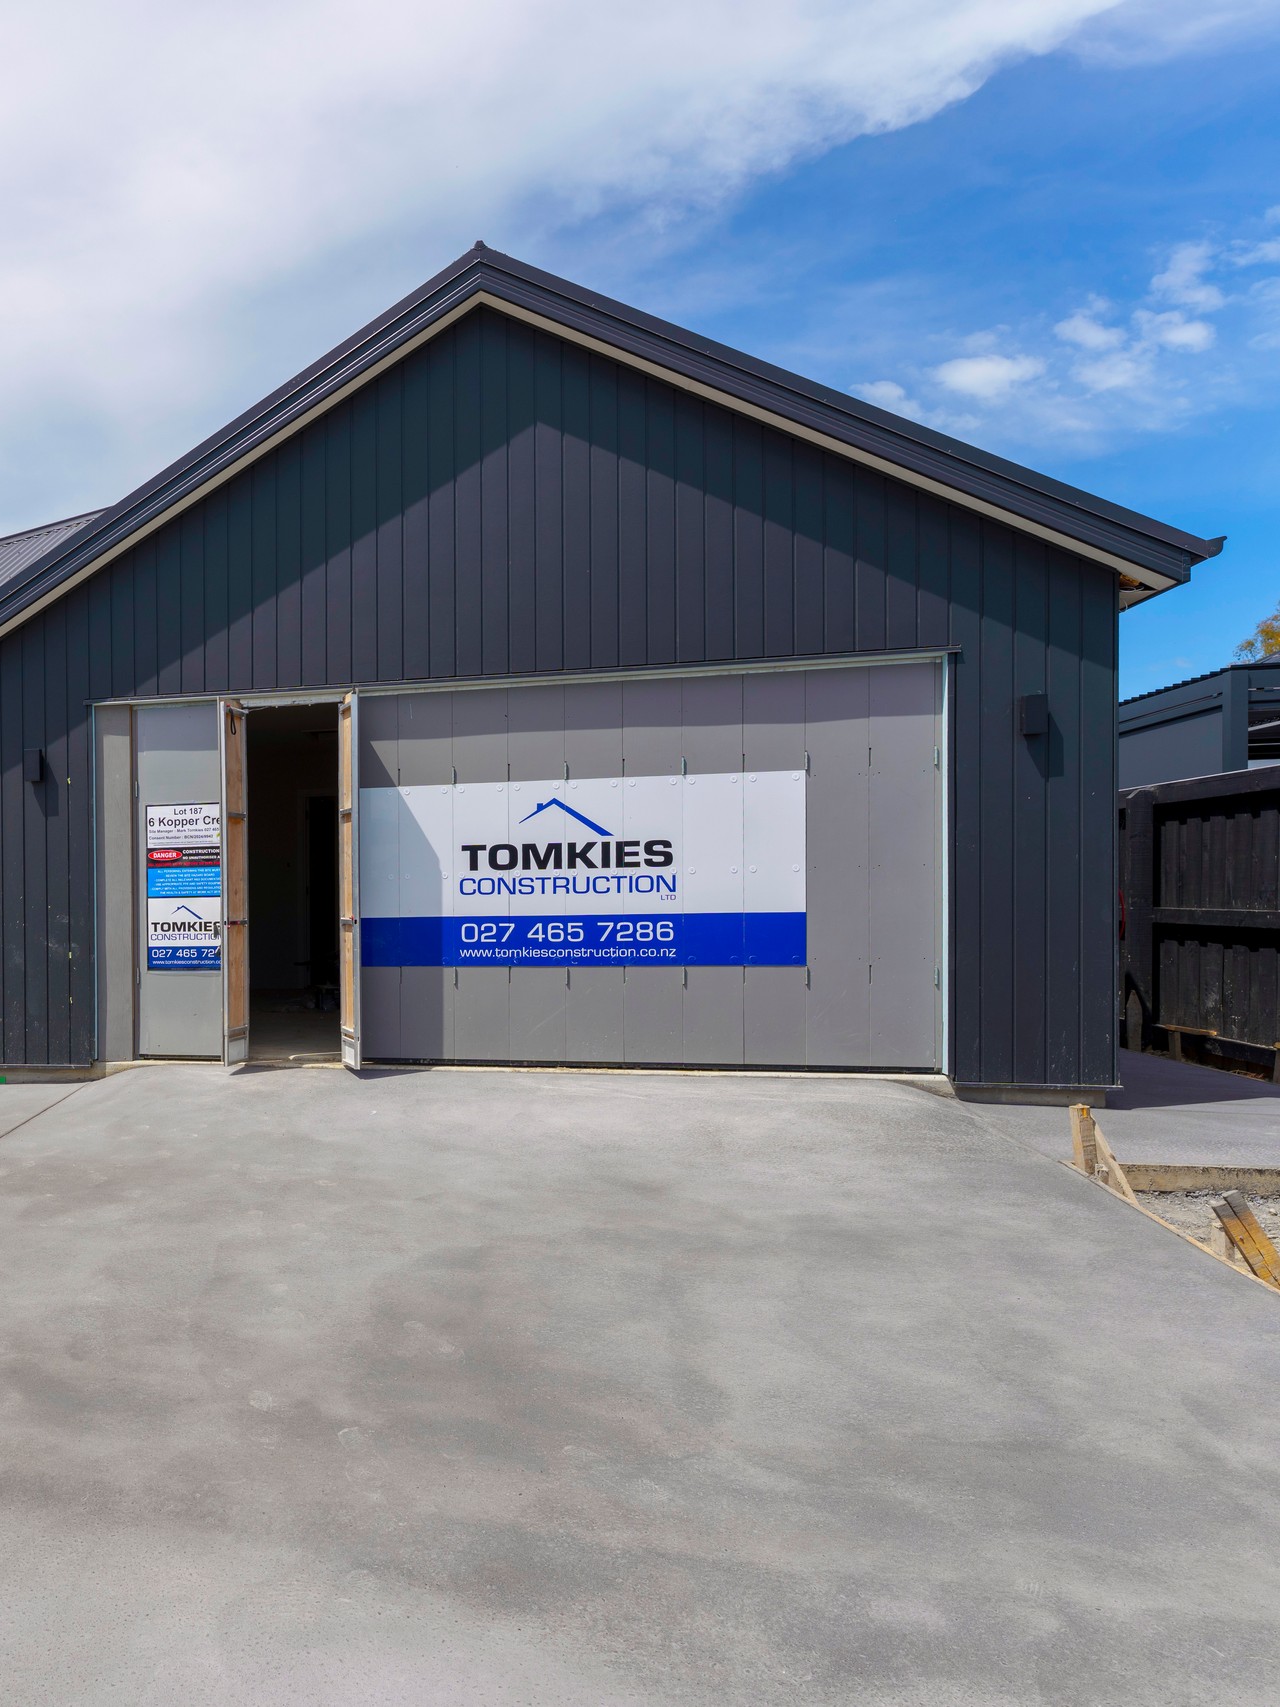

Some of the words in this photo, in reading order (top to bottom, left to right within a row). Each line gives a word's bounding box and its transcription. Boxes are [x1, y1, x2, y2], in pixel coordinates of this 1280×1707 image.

[173, 808, 187, 816] Lot
[189, 807, 203, 815] 187
[148, 817, 155, 827] 6
[158, 816, 200, 829] Kopper
[461, 839, 674, 871] TOMKIES
[459, 874, 677, 896] CONSTRUCTION
[461, 923, 516, 943] 027
[527, 922, 585, 943] 465
[596, 921, 675, 942] 7286
[151, 949, 173, 958] 027
[176, 948, 198, 958] 465
[201, 948, 216, 958] 72
[459, 945, 677, 958] www.tomkiesconstruction.co.nz
